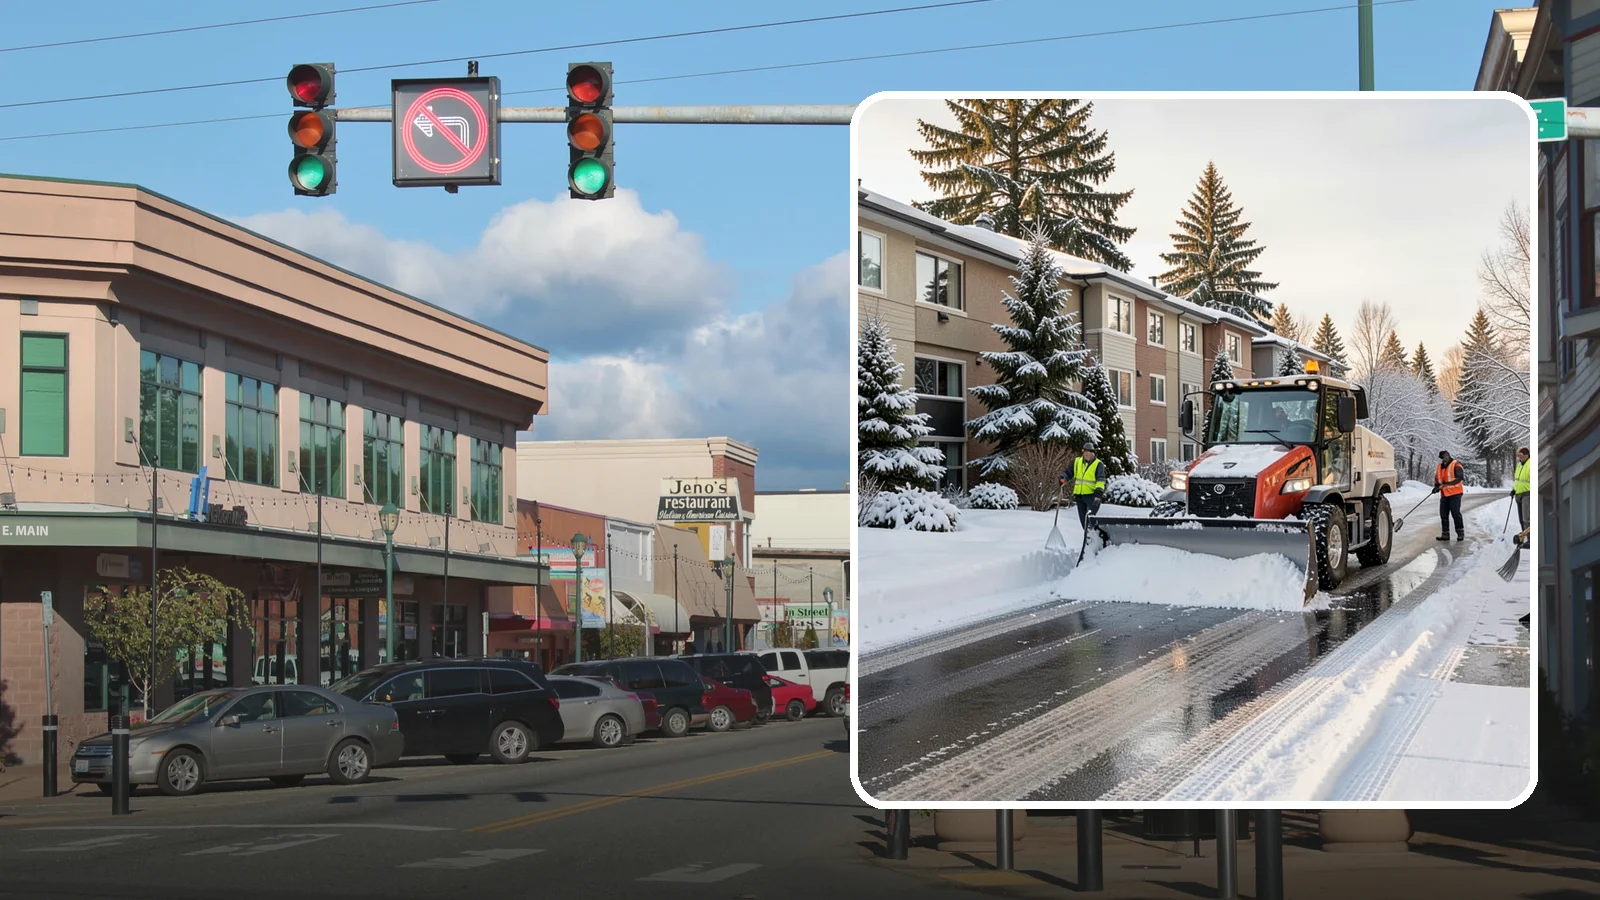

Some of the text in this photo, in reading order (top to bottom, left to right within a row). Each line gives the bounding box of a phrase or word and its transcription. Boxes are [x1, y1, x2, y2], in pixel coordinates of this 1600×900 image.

[669, 480, 727, 494] Jeno's
[665, 496, 731, 509] restaurant
[659, 510, 681, 520] Italian
[686, 509, 714, 519] American
[715, 509, 737, 519] Cuisine
[2, 525, 49, 536] E. MAIN
[798, 608, 828, 617] Street
